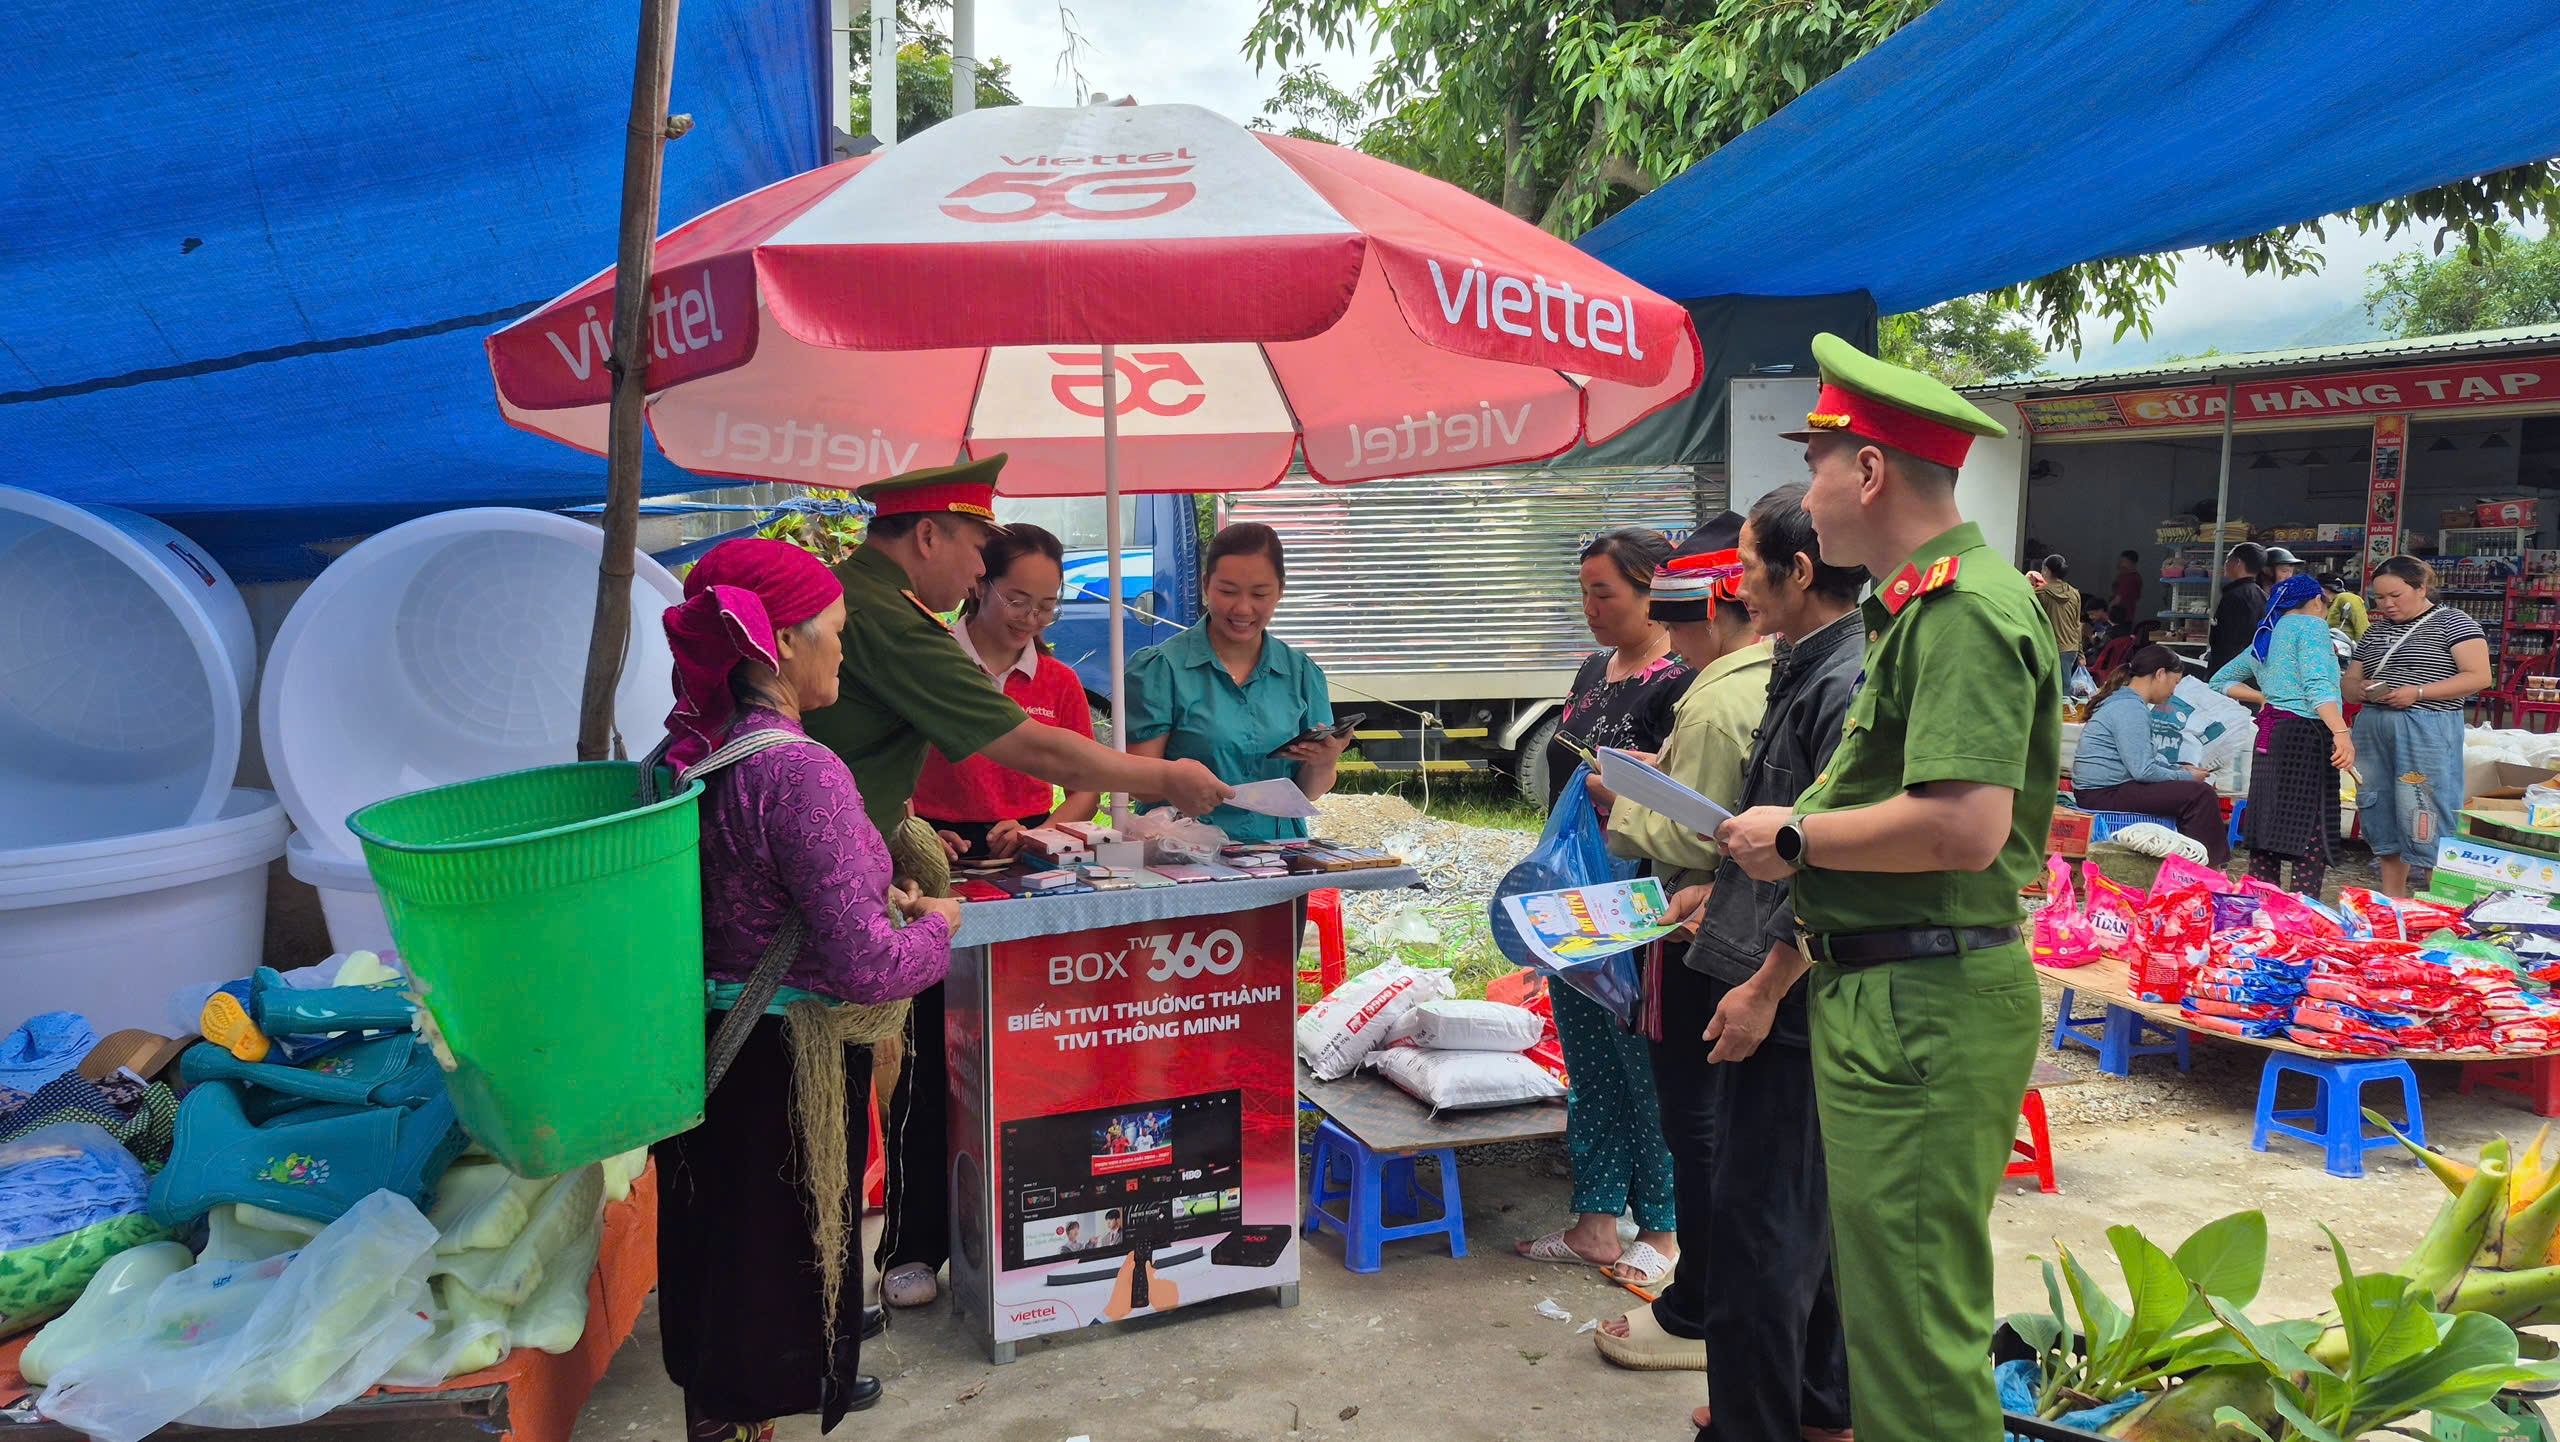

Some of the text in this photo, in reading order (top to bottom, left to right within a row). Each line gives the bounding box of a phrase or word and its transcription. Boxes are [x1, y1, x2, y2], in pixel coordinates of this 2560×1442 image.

[1000, 147, 1196, 168] viettel
[938, 165, 1197, 223] 5G
[544, 269, 723, 381] vittel
[1428, 257, 1644, 361] viettel
[2250, 378, 2402, 414] HÀNG
[2414, 372, 2541, 402] TẠP
[2374, 480, 2396, 489] CỬA
[1049, 950, 1129, 986] BOX
[1146, 928, 1244, 983] 360
[1007, 984, 1281, 1032] BIẾN TIVI THƯỜNG THÀNH
[1054, 1014, 1240, 1052] TIVI THÔNG MINH
[1181, 1169, 1203, 1182] HBO
[1010, 1305, 1057, 1323] viettel
